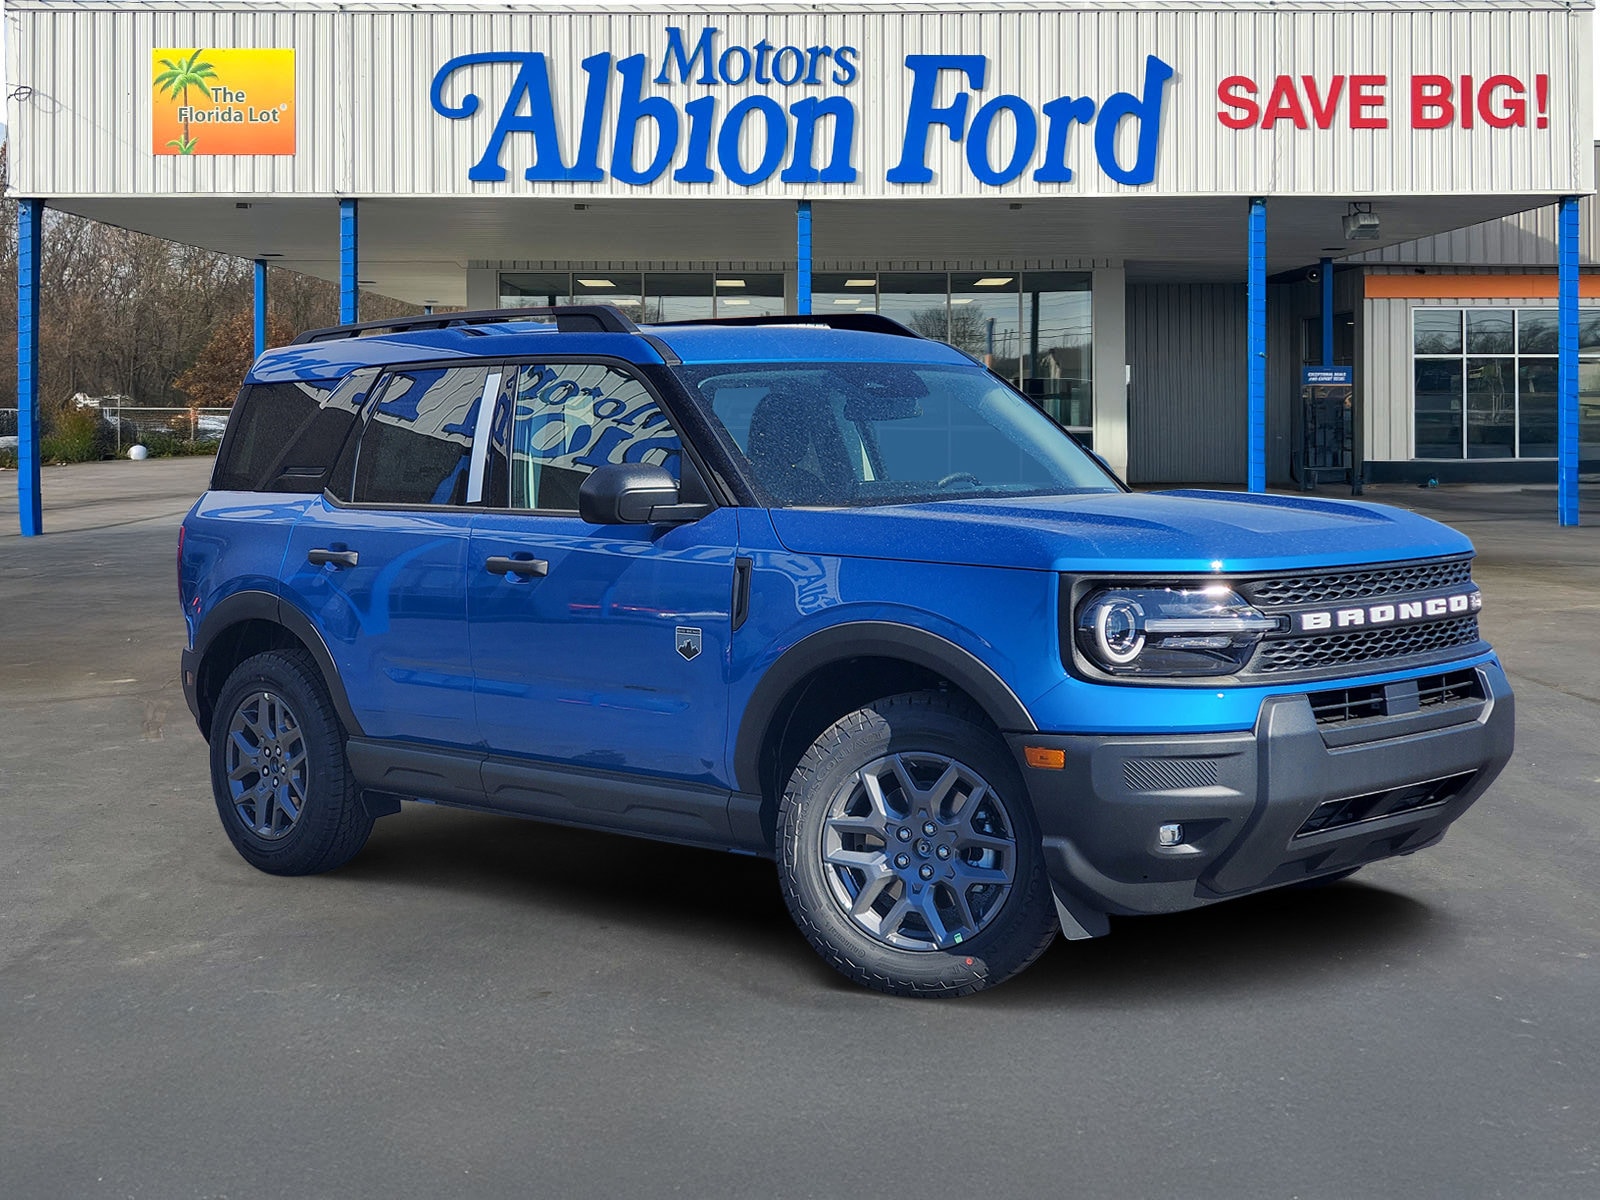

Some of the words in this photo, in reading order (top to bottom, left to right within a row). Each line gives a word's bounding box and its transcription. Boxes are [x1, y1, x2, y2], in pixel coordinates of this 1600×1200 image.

[655, 27, 857, 86] Motors
[178, 106, 243, 122] Florida
[248, 106, 279, 122] Lot
[211, 86, 245, 103] The
[1217, 74, 1388, 129] SAVE
[1411, 74, 1548, 129] BIG!
[430, 51, 857, 186] Albion
[886, 54, 1174, 186] Ford
[1301, 595, 1468, 630] BRONCO
